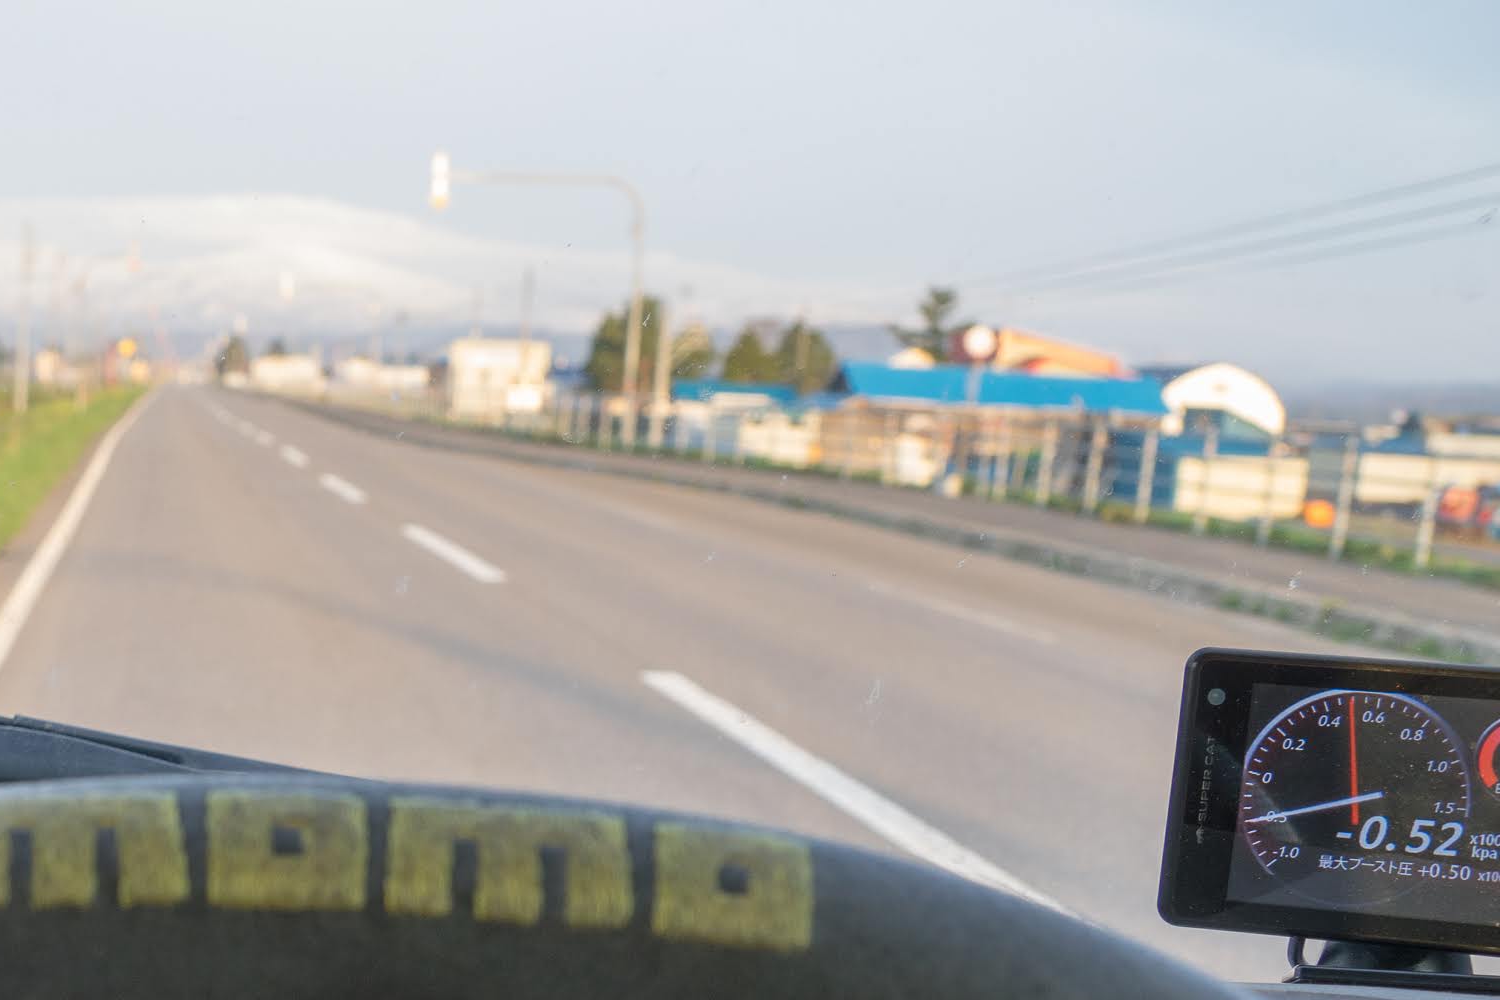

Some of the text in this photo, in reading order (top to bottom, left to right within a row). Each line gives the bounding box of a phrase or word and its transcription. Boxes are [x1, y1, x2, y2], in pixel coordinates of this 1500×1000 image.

[1318, 715, 1341, 728] 0.4
[1362, 711, 1385, 724] 0.6
[1400, 728, 1423, 741] 0.8
[1282, 738, 1305, 751] 0.2
[1426, 760, 1448, 773] 1.0
[1197, 736, 1216, 820] SUPER CAT
[1261, 771, 1272, 784] 0
[1433, 801, 1455, 814] 1.5
[1336, 815, 1464, 857] -0.52
[1273, 845, 1300, 859] -1.0
[1319, 854, 1413, 876] 最大ブースト圧
[1417, 863, 1472, 881] +0.50
